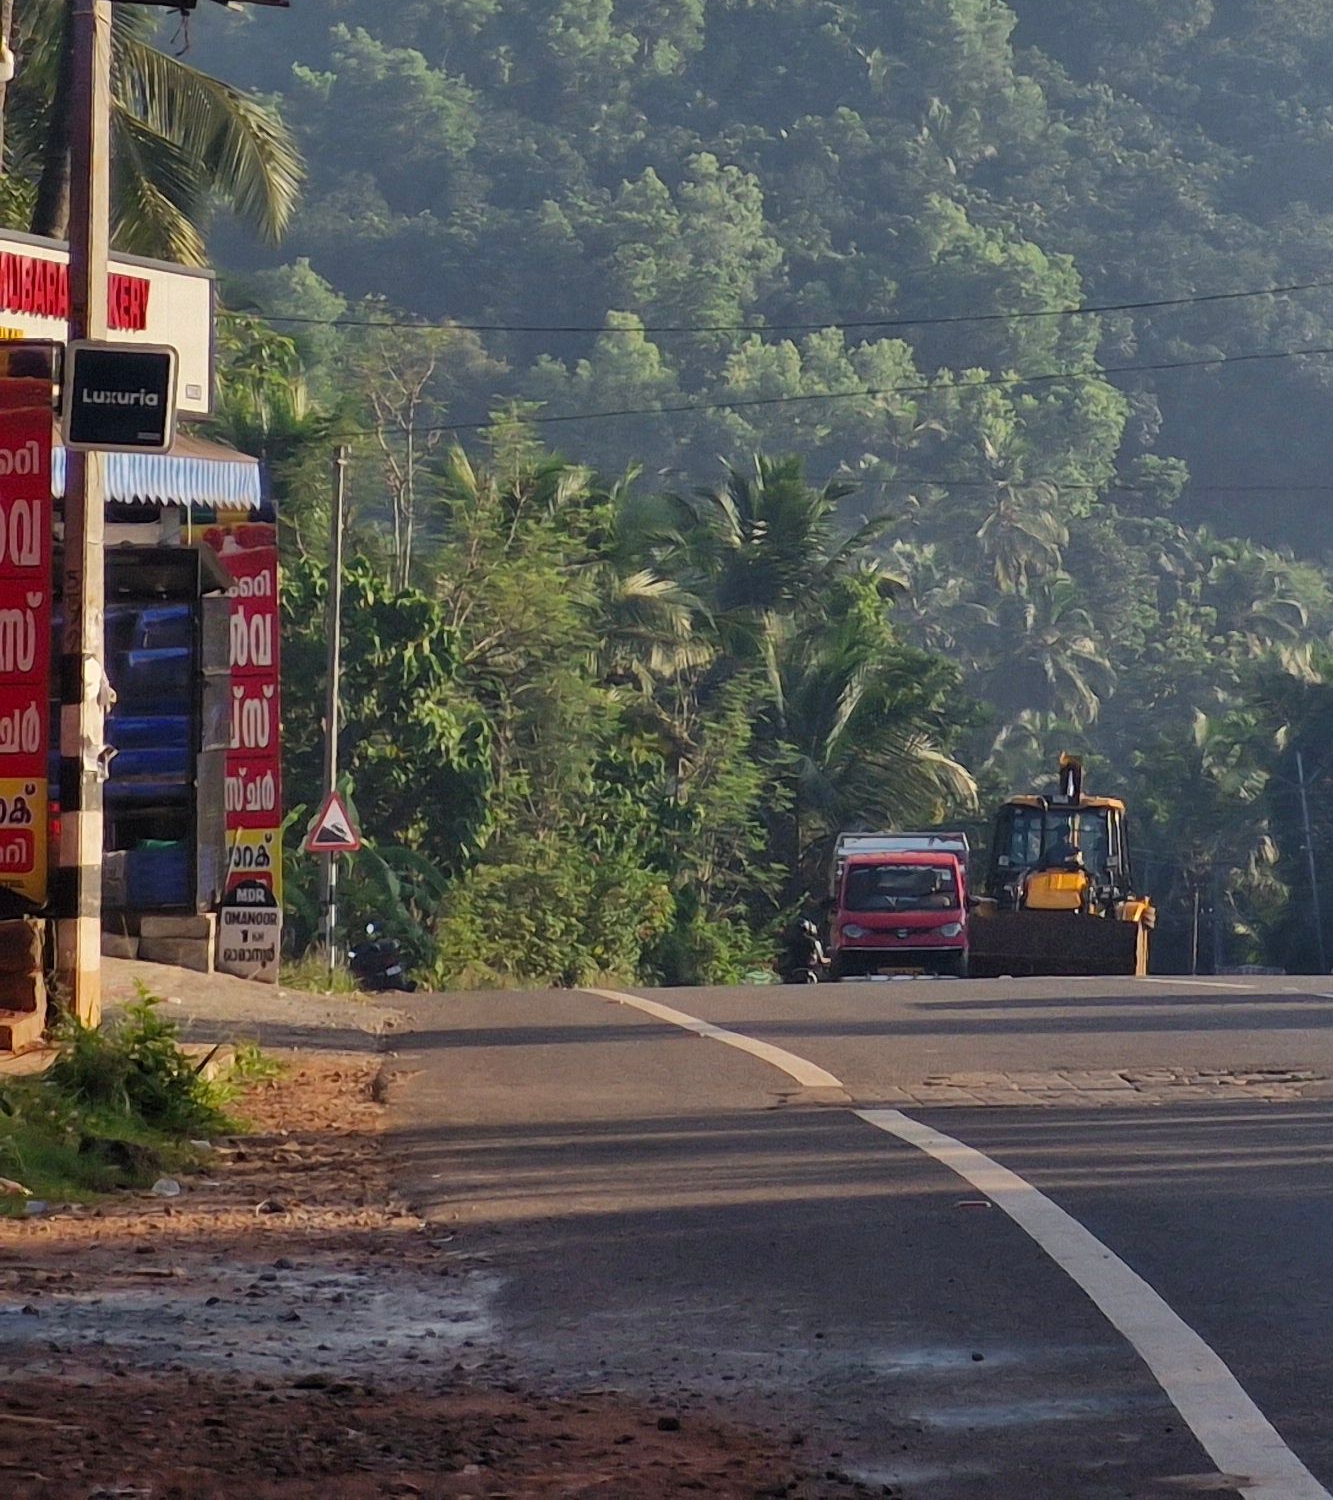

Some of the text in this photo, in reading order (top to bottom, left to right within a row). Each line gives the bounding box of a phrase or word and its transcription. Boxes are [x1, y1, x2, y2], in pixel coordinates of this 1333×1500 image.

[0, 251, 70, 320] MUBARA
[82, 388, 158, 407] Luxuria
[236, 888, 266, 903] MDR
[225, 911, 277, 925] OMANOOR
[241, 929, 248, 943] 1
